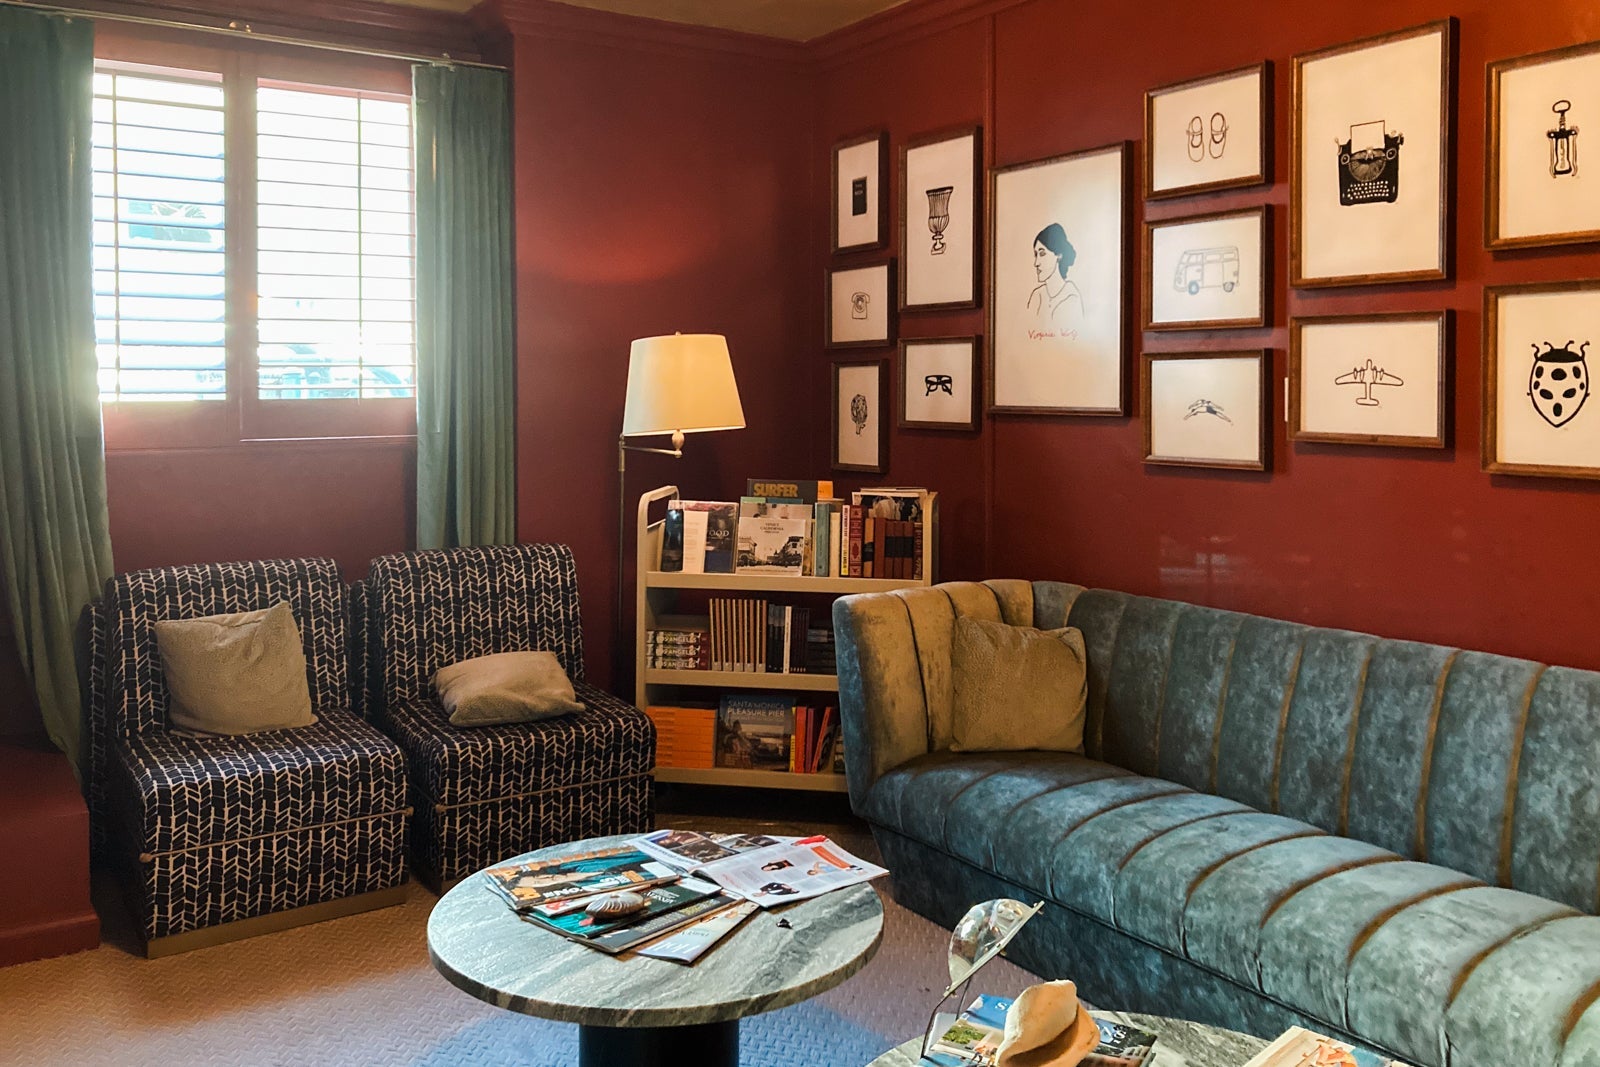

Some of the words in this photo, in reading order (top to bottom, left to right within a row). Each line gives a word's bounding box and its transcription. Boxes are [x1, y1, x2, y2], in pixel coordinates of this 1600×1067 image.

[753, 483, 798, 497] SURFER
[728, 708, 767, 717] PLEASURE
[768, 710, 784, 718] PIER
